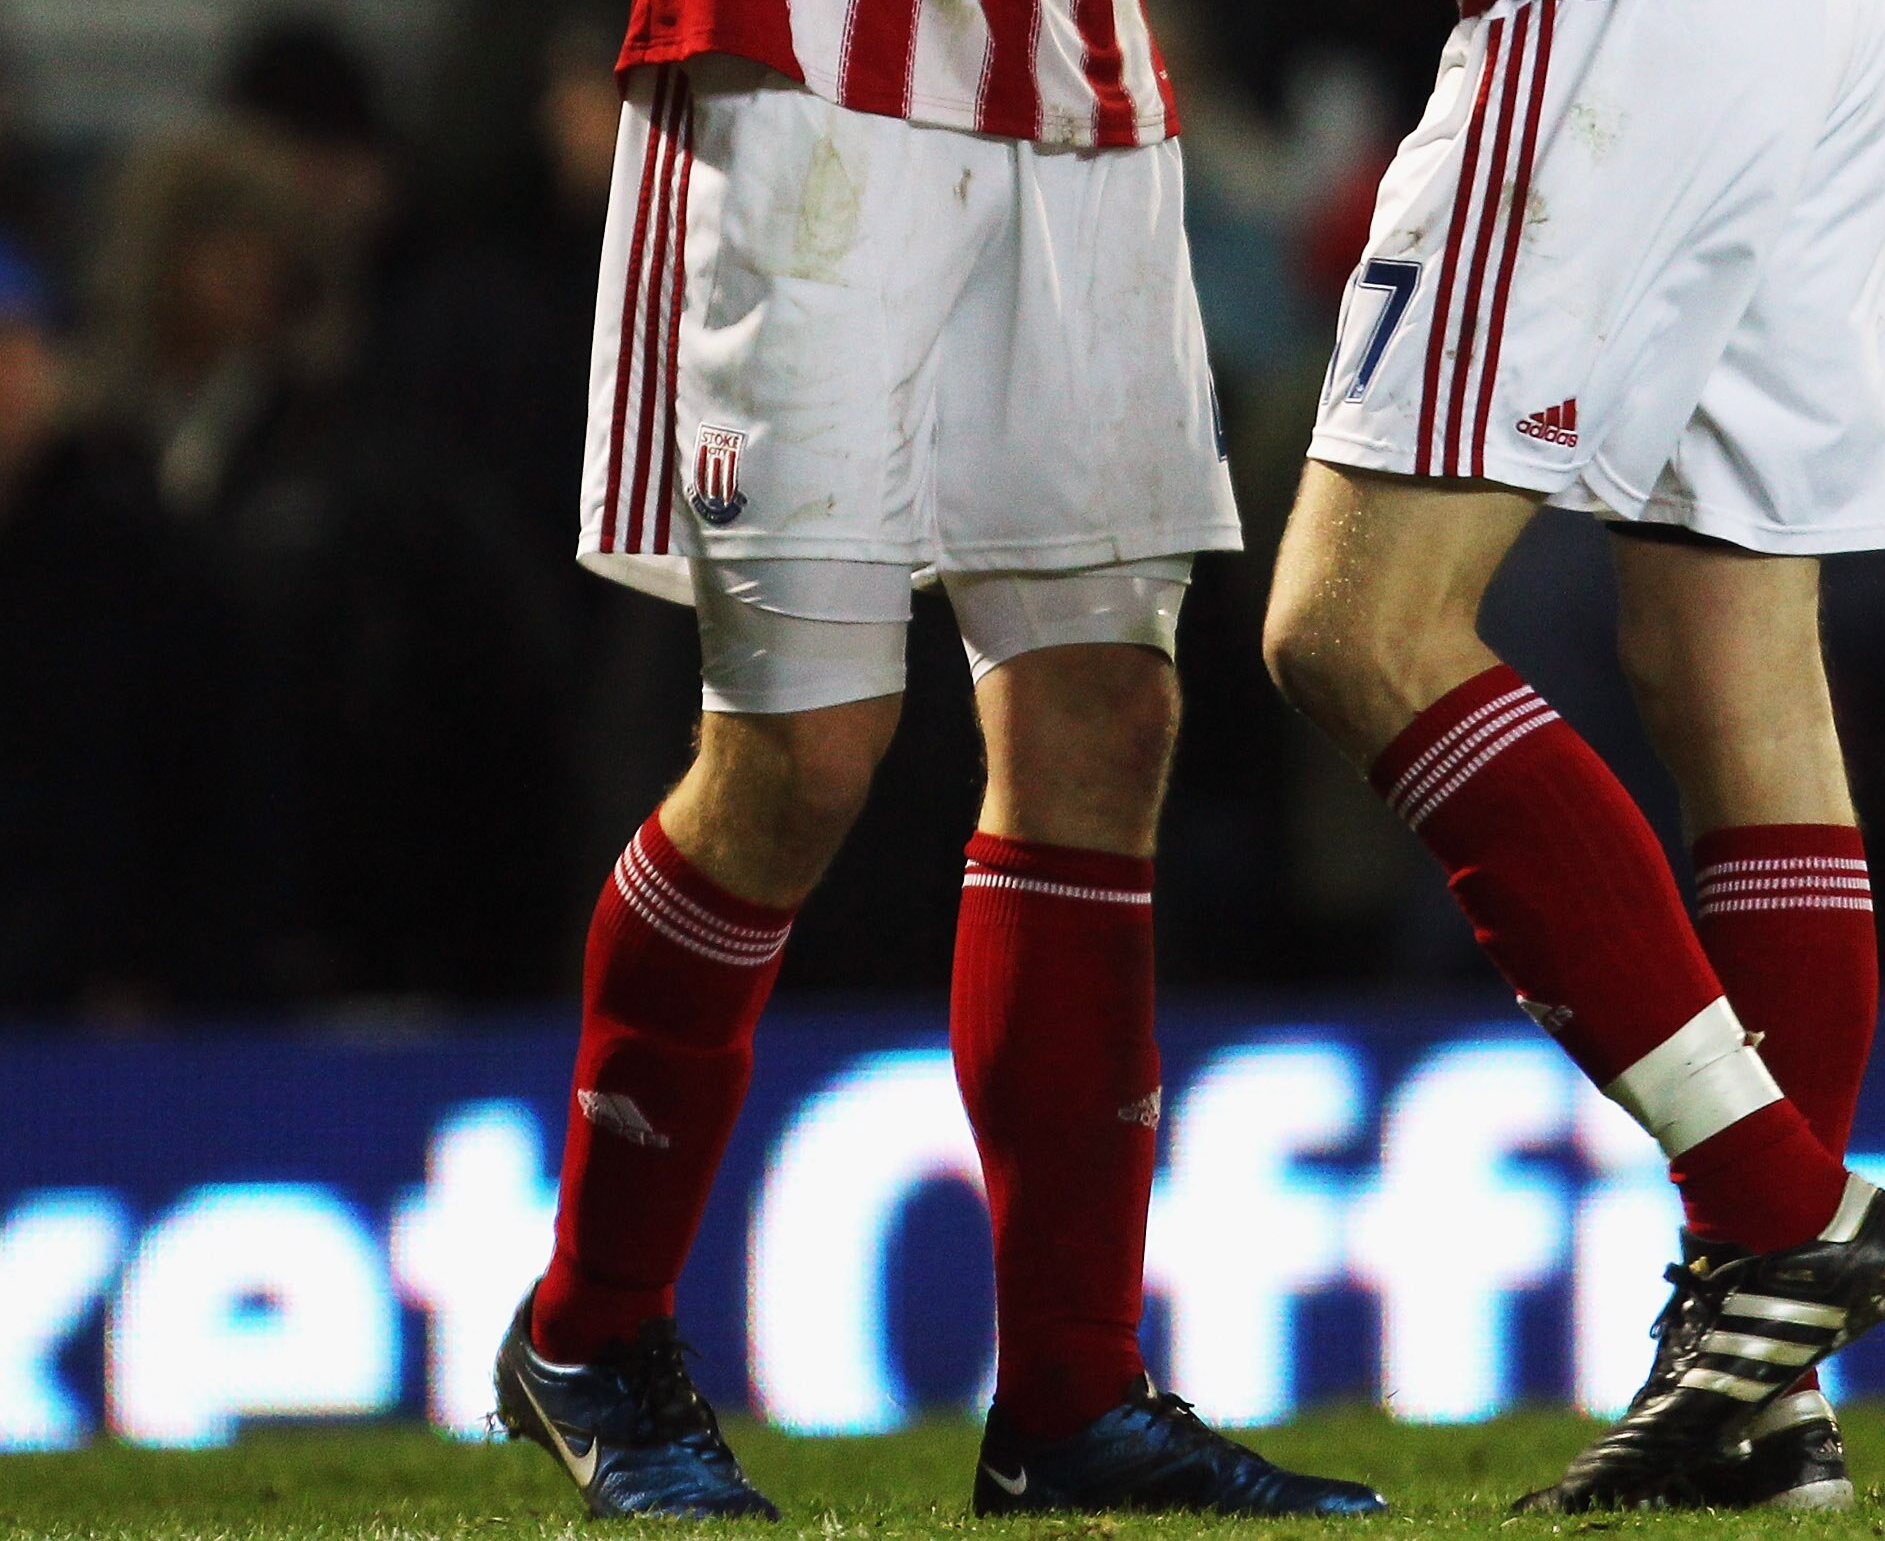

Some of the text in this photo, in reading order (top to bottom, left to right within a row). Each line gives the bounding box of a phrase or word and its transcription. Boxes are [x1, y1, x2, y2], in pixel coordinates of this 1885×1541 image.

[1322, 257, 1423, 405] 7
[702, 431, 739, 450] STOKE
[1516, 420, 1578, 448] adidas
[708, 446, 729, 457] CITY
